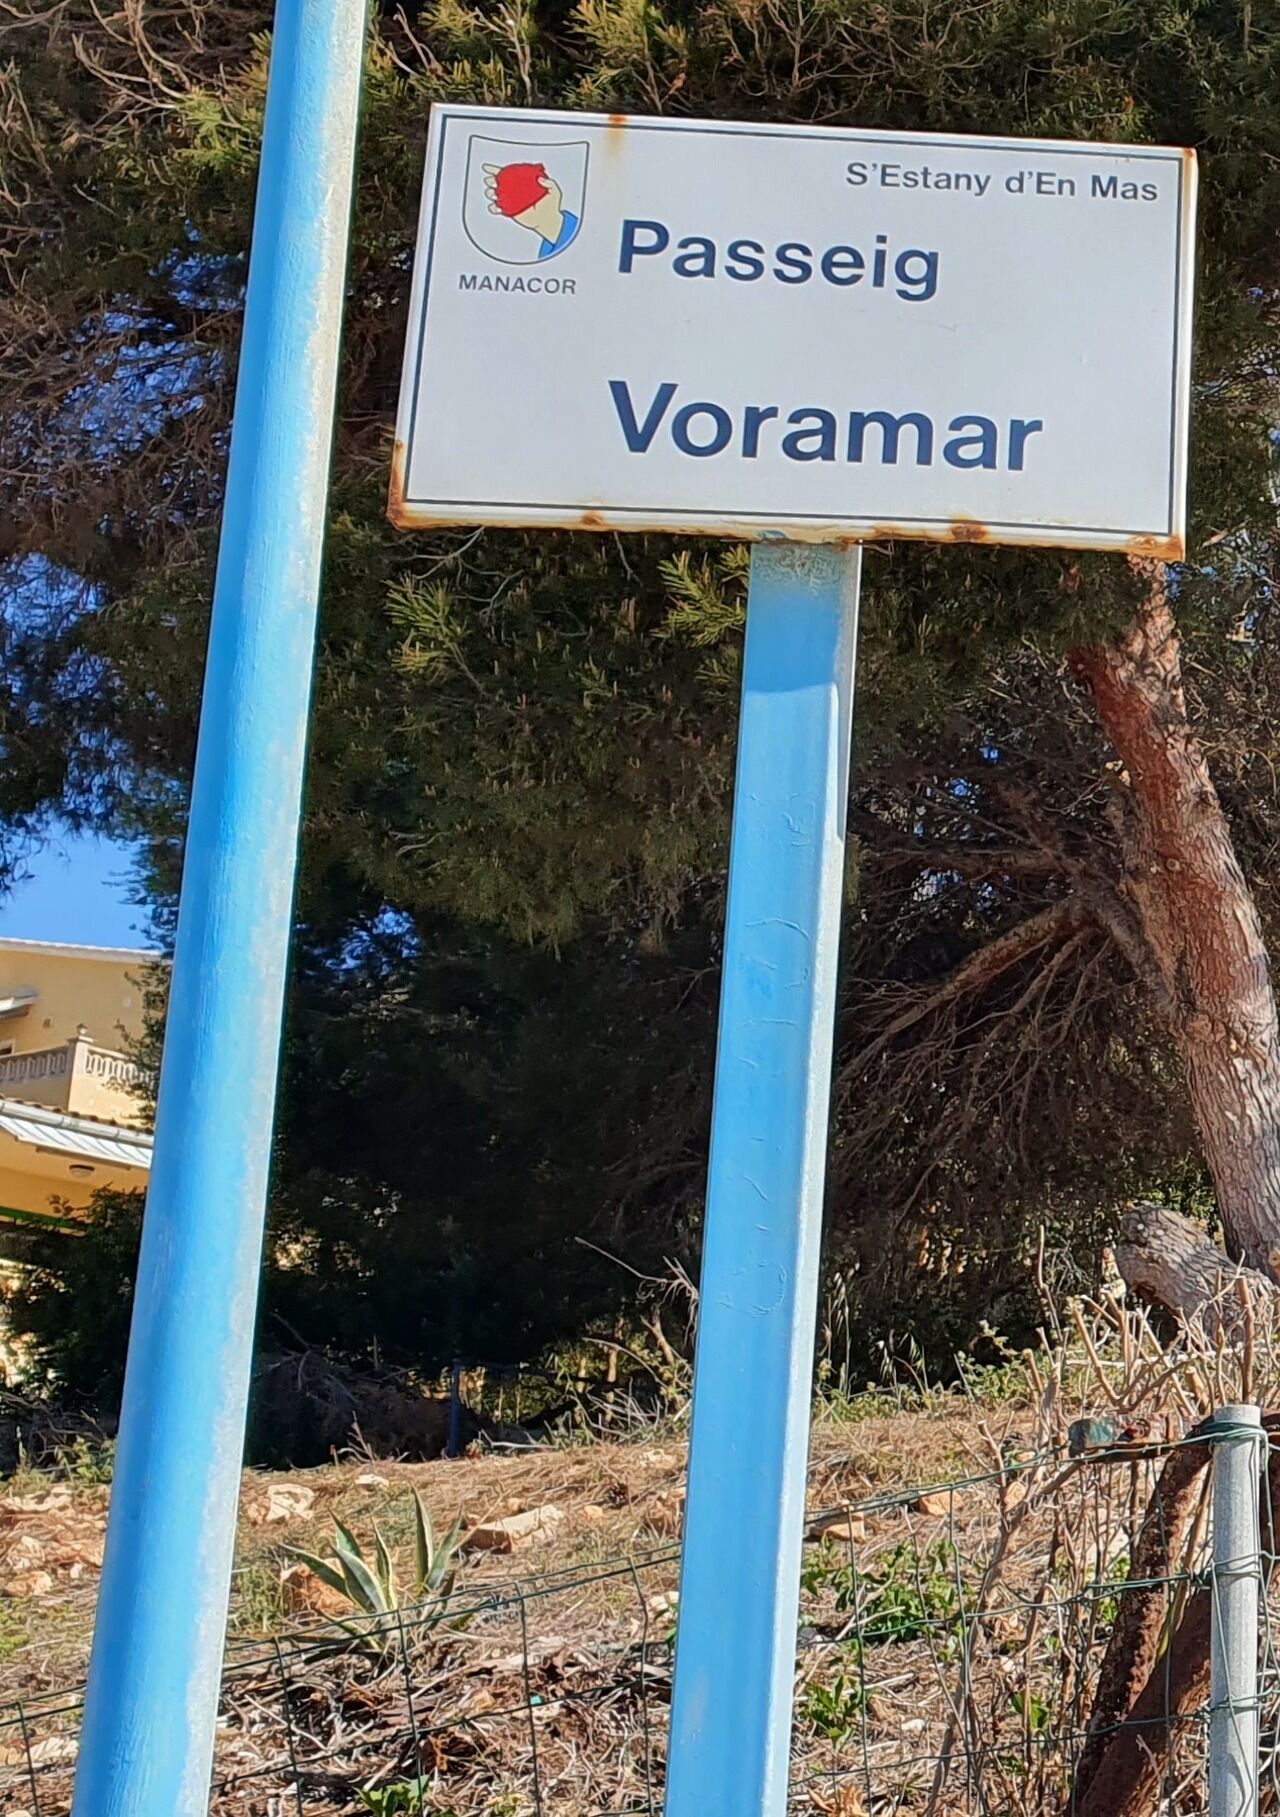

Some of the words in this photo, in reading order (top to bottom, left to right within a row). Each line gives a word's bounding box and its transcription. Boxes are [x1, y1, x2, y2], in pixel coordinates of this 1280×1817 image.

[846, 162, 992, 197] S'Estany
[1005, 170, 1076, 197] d'En
[1091, 174, 1159, 201] Mas
[458, 274, 577, 295] MANACOR
[618, 219, 940, 302] Passeig
[608, 380, 1044, 471] Voramar
